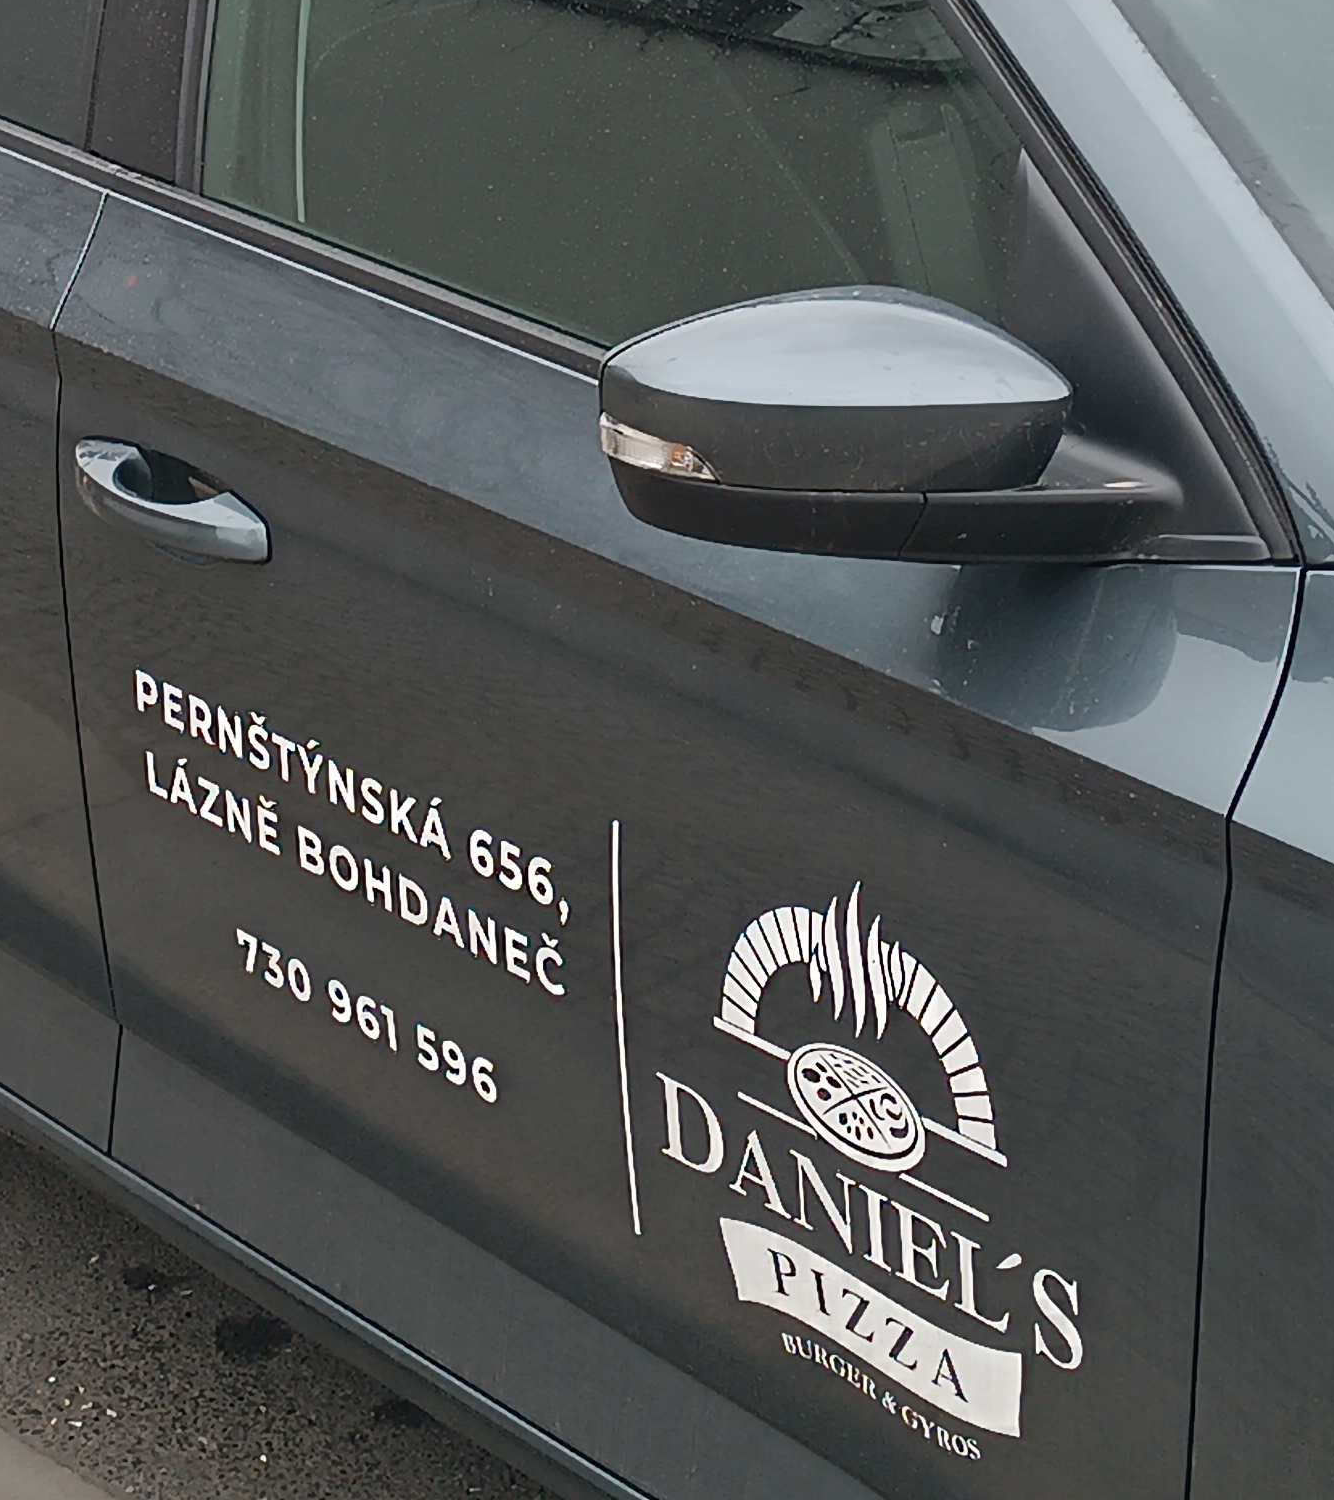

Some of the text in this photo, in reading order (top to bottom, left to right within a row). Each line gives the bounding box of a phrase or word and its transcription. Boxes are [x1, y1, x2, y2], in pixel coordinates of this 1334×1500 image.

[134, 669, 571, 926] PERNŠTÝNSKÁ 656,
[145, 750, 567, 997] LÁZNĚ BOHDANEČ
[235, 928, 498, 1104] 730 961 596
[766, 1247, 969, 1403] PIZZA
[781, 1331, 983, 1462] BURGER & GYROS
